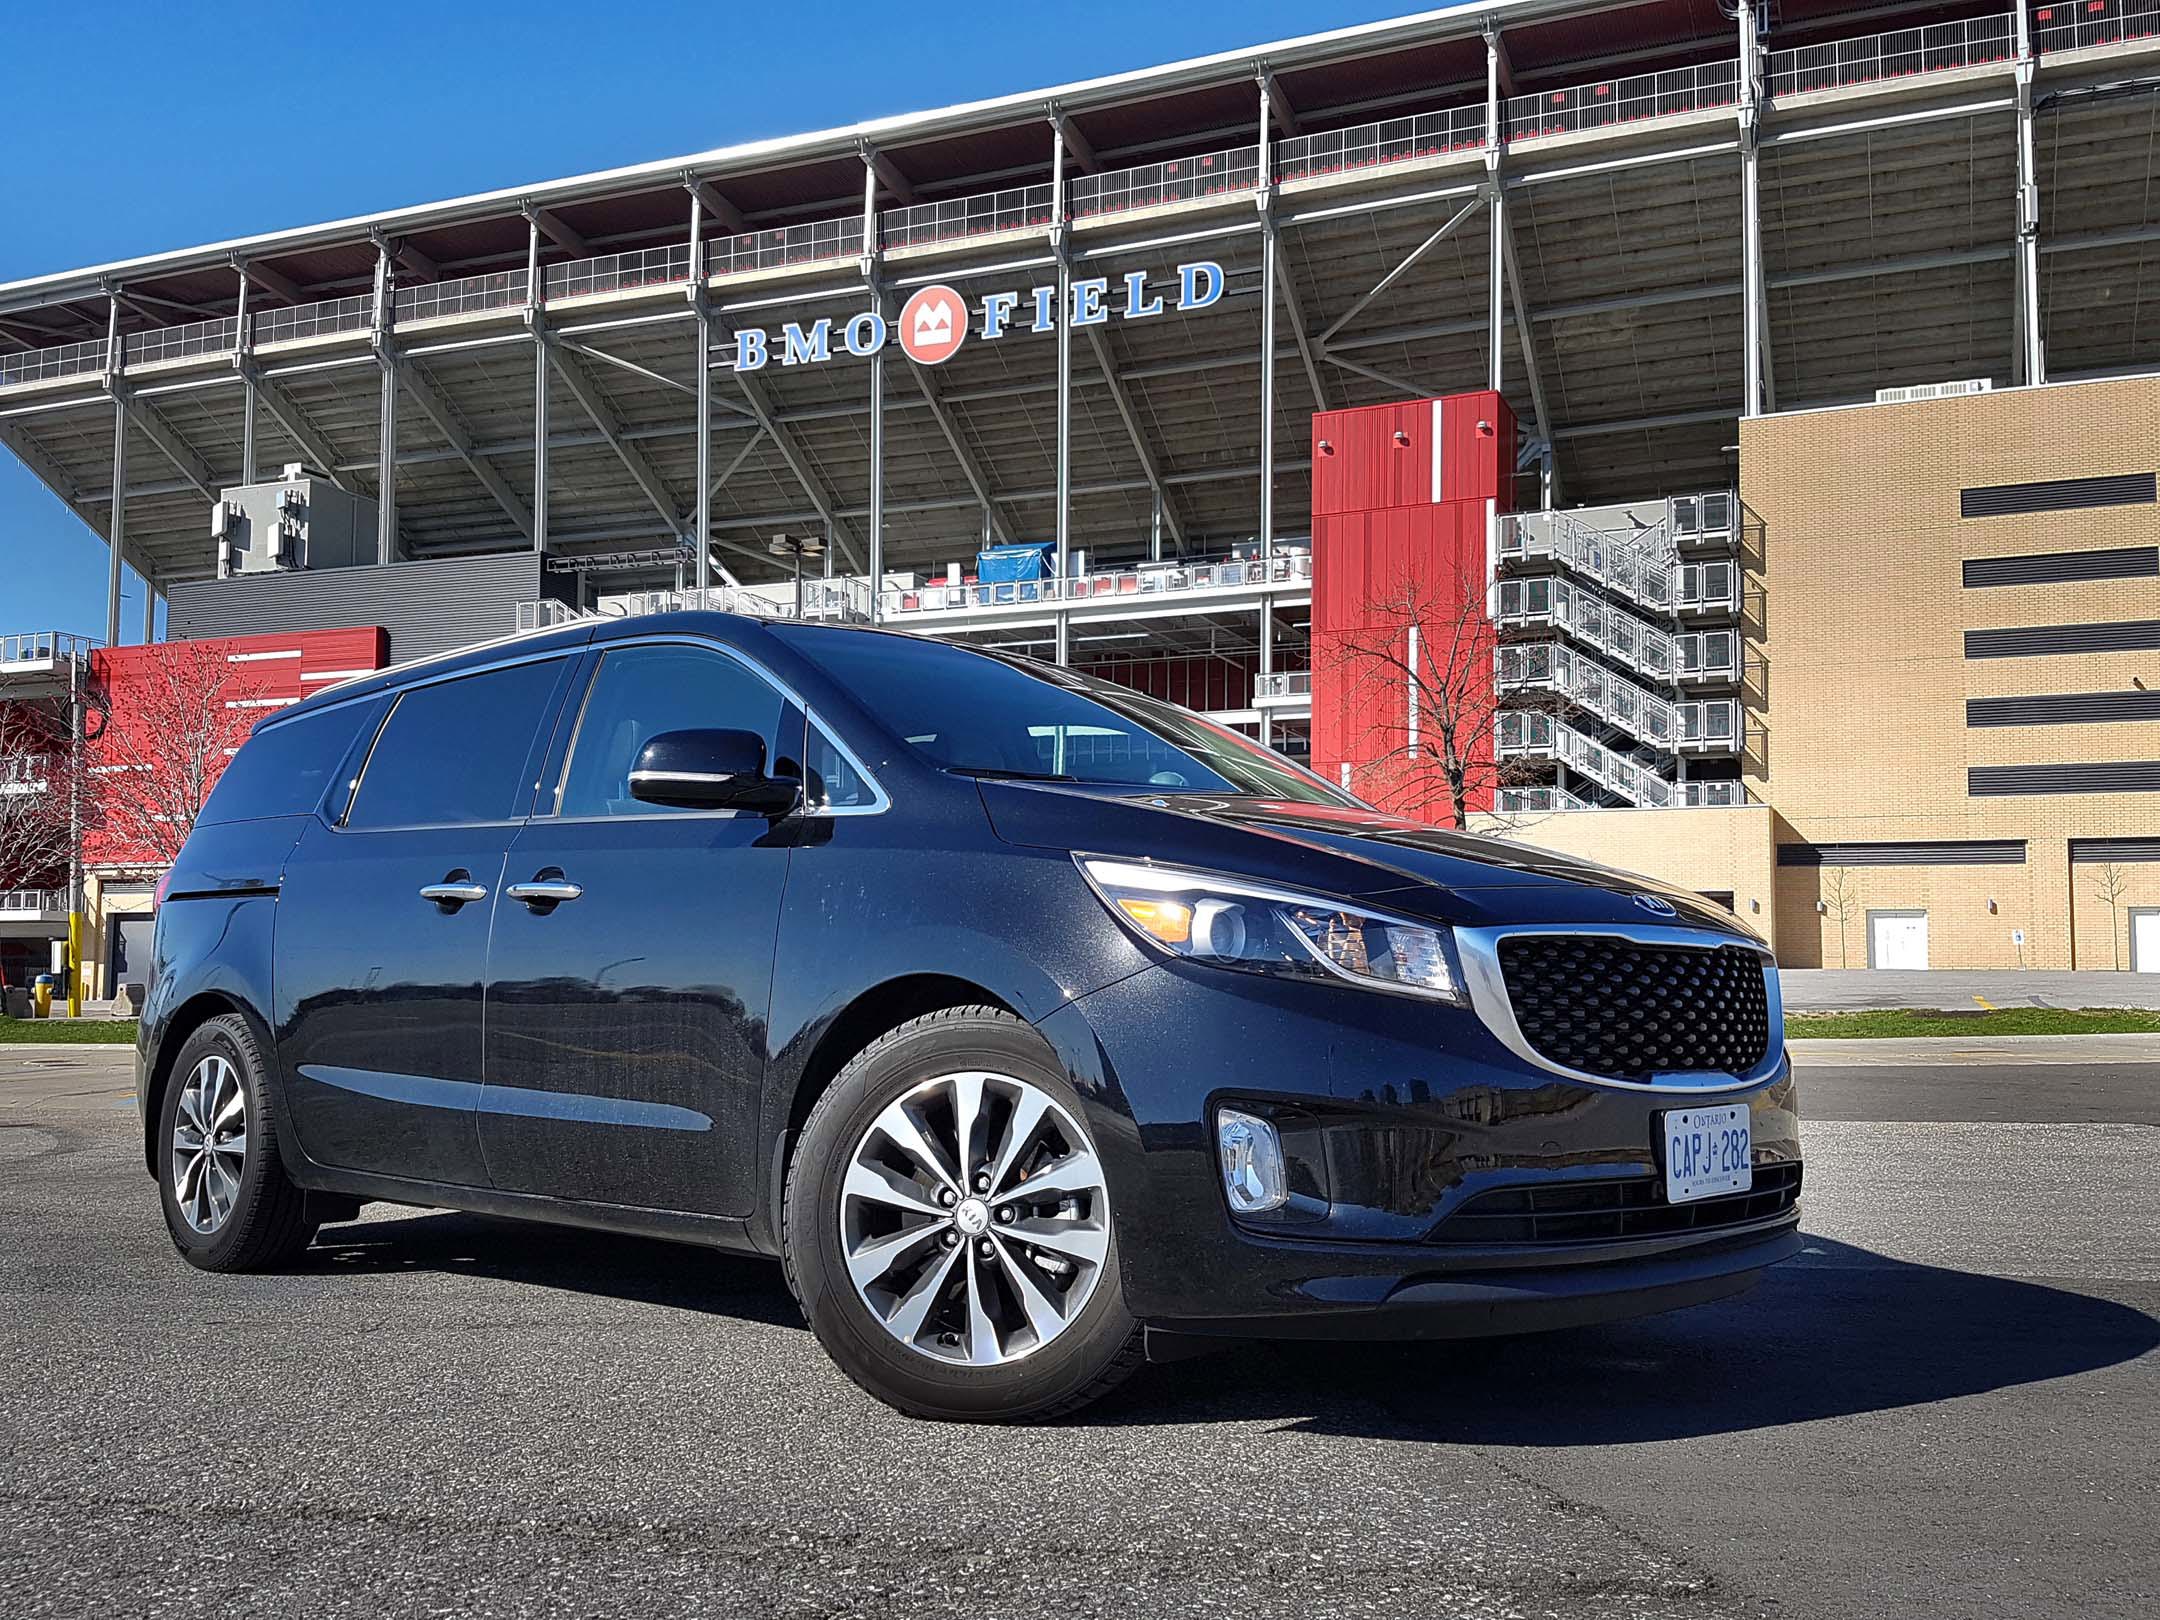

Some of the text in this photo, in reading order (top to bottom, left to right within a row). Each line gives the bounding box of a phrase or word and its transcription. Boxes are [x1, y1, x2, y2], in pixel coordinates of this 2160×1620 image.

[734, 261, 1224, 372] BMO FIELD
[1693, 1112, 1727, 1129] ONTARIO
[1672, 1128, 1749, 1179] CAPJ 282
[961, 1205, 983, 1231] KIA
